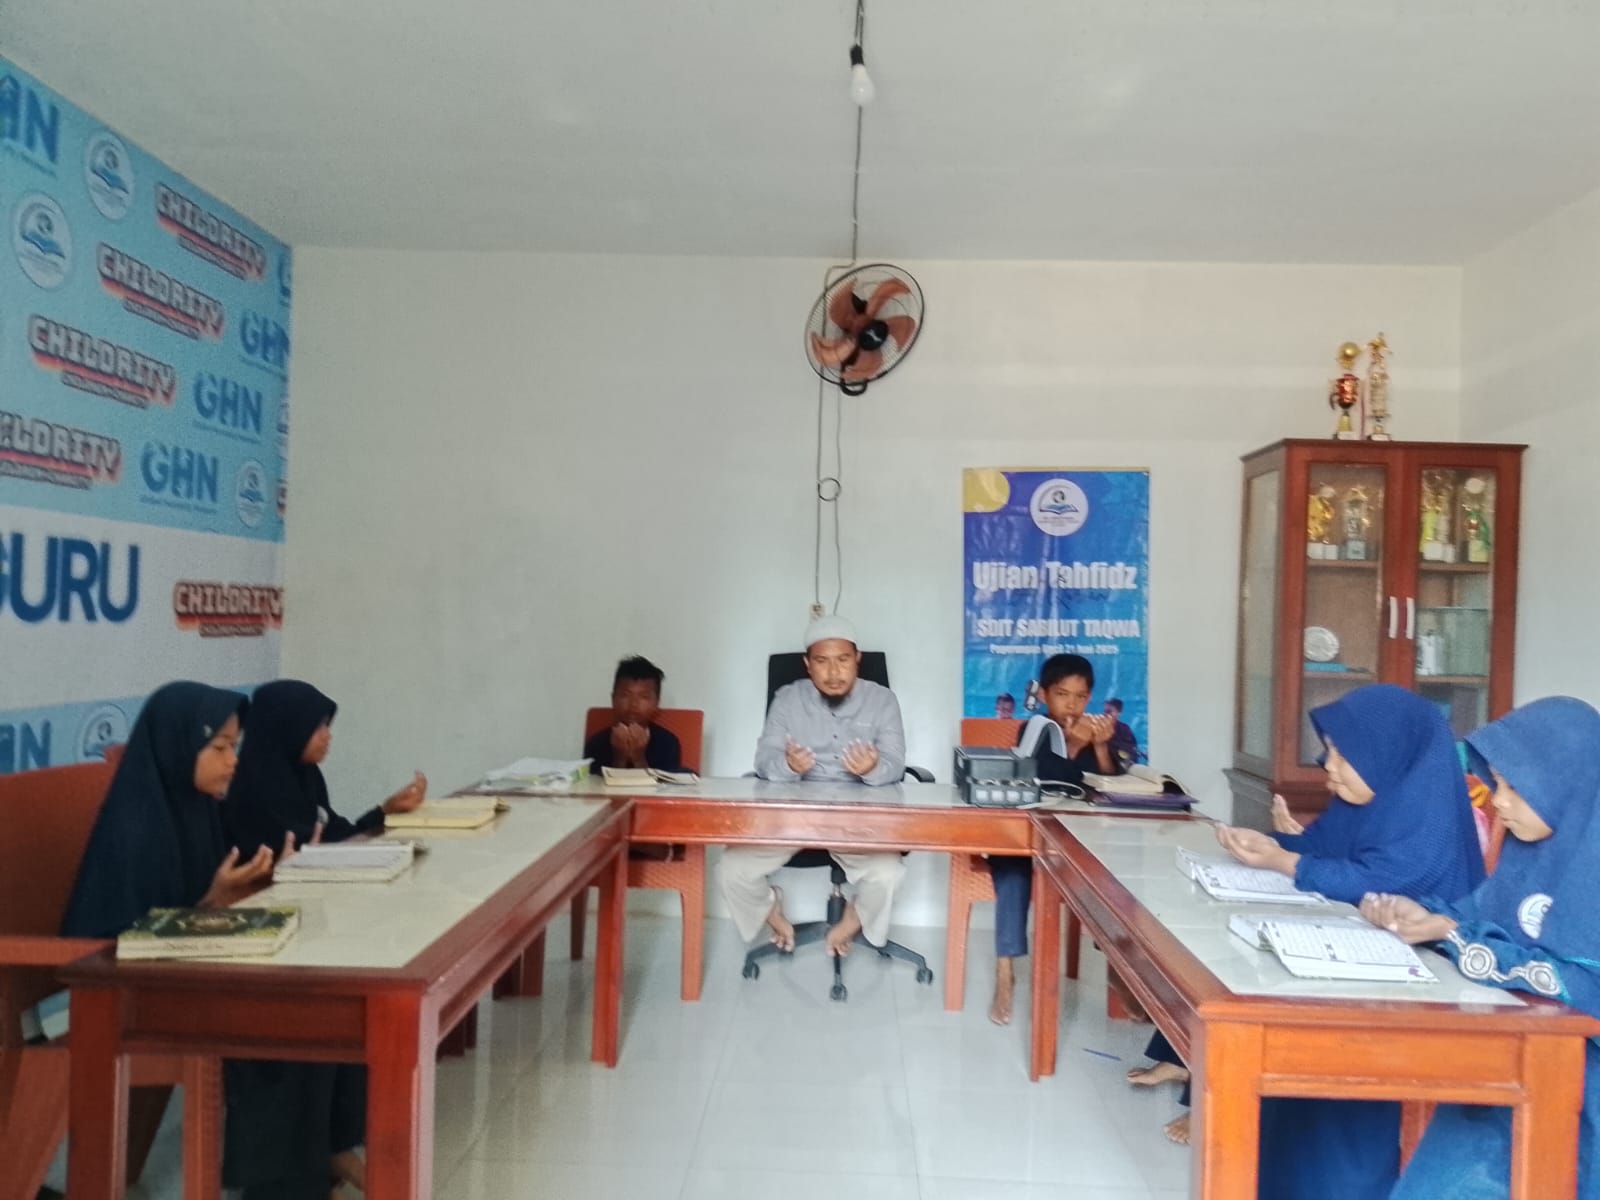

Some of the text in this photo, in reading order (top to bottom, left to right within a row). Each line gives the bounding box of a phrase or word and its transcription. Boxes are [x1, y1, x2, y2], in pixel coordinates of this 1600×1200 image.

[194, 371, 262, 434] GHN
[141, 440, 219, 502] GHN
[0, 531, 140, 623] URU
[972, 561, 1138, 593] Ujian Tahfidz
